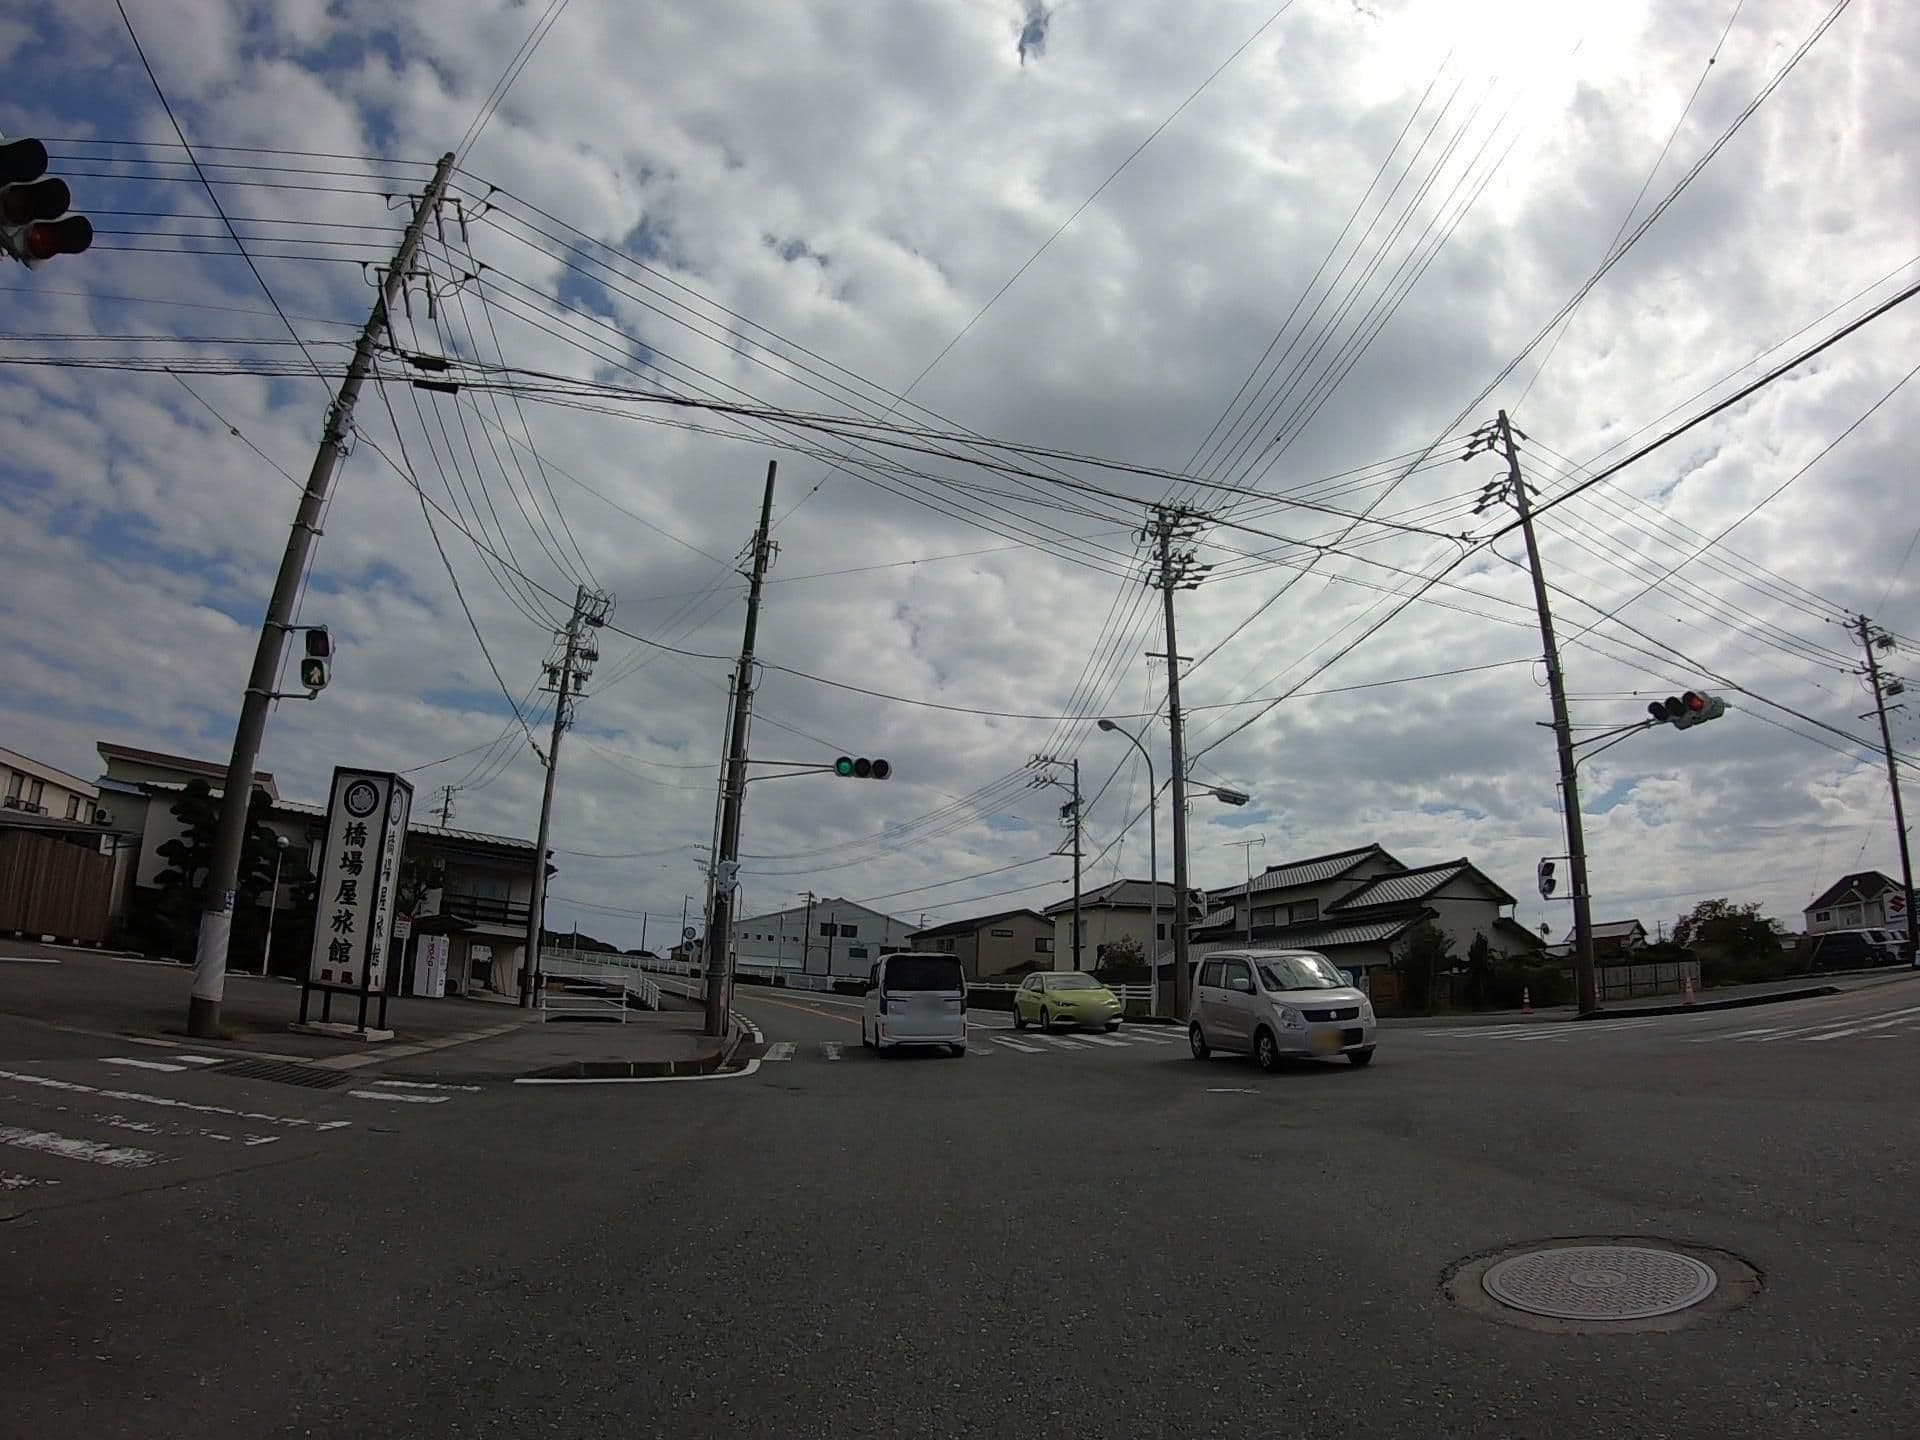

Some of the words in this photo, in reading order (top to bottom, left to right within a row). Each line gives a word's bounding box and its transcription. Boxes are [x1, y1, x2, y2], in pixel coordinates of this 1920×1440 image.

[328, 821, 368, 964] 橋場屋旅館
